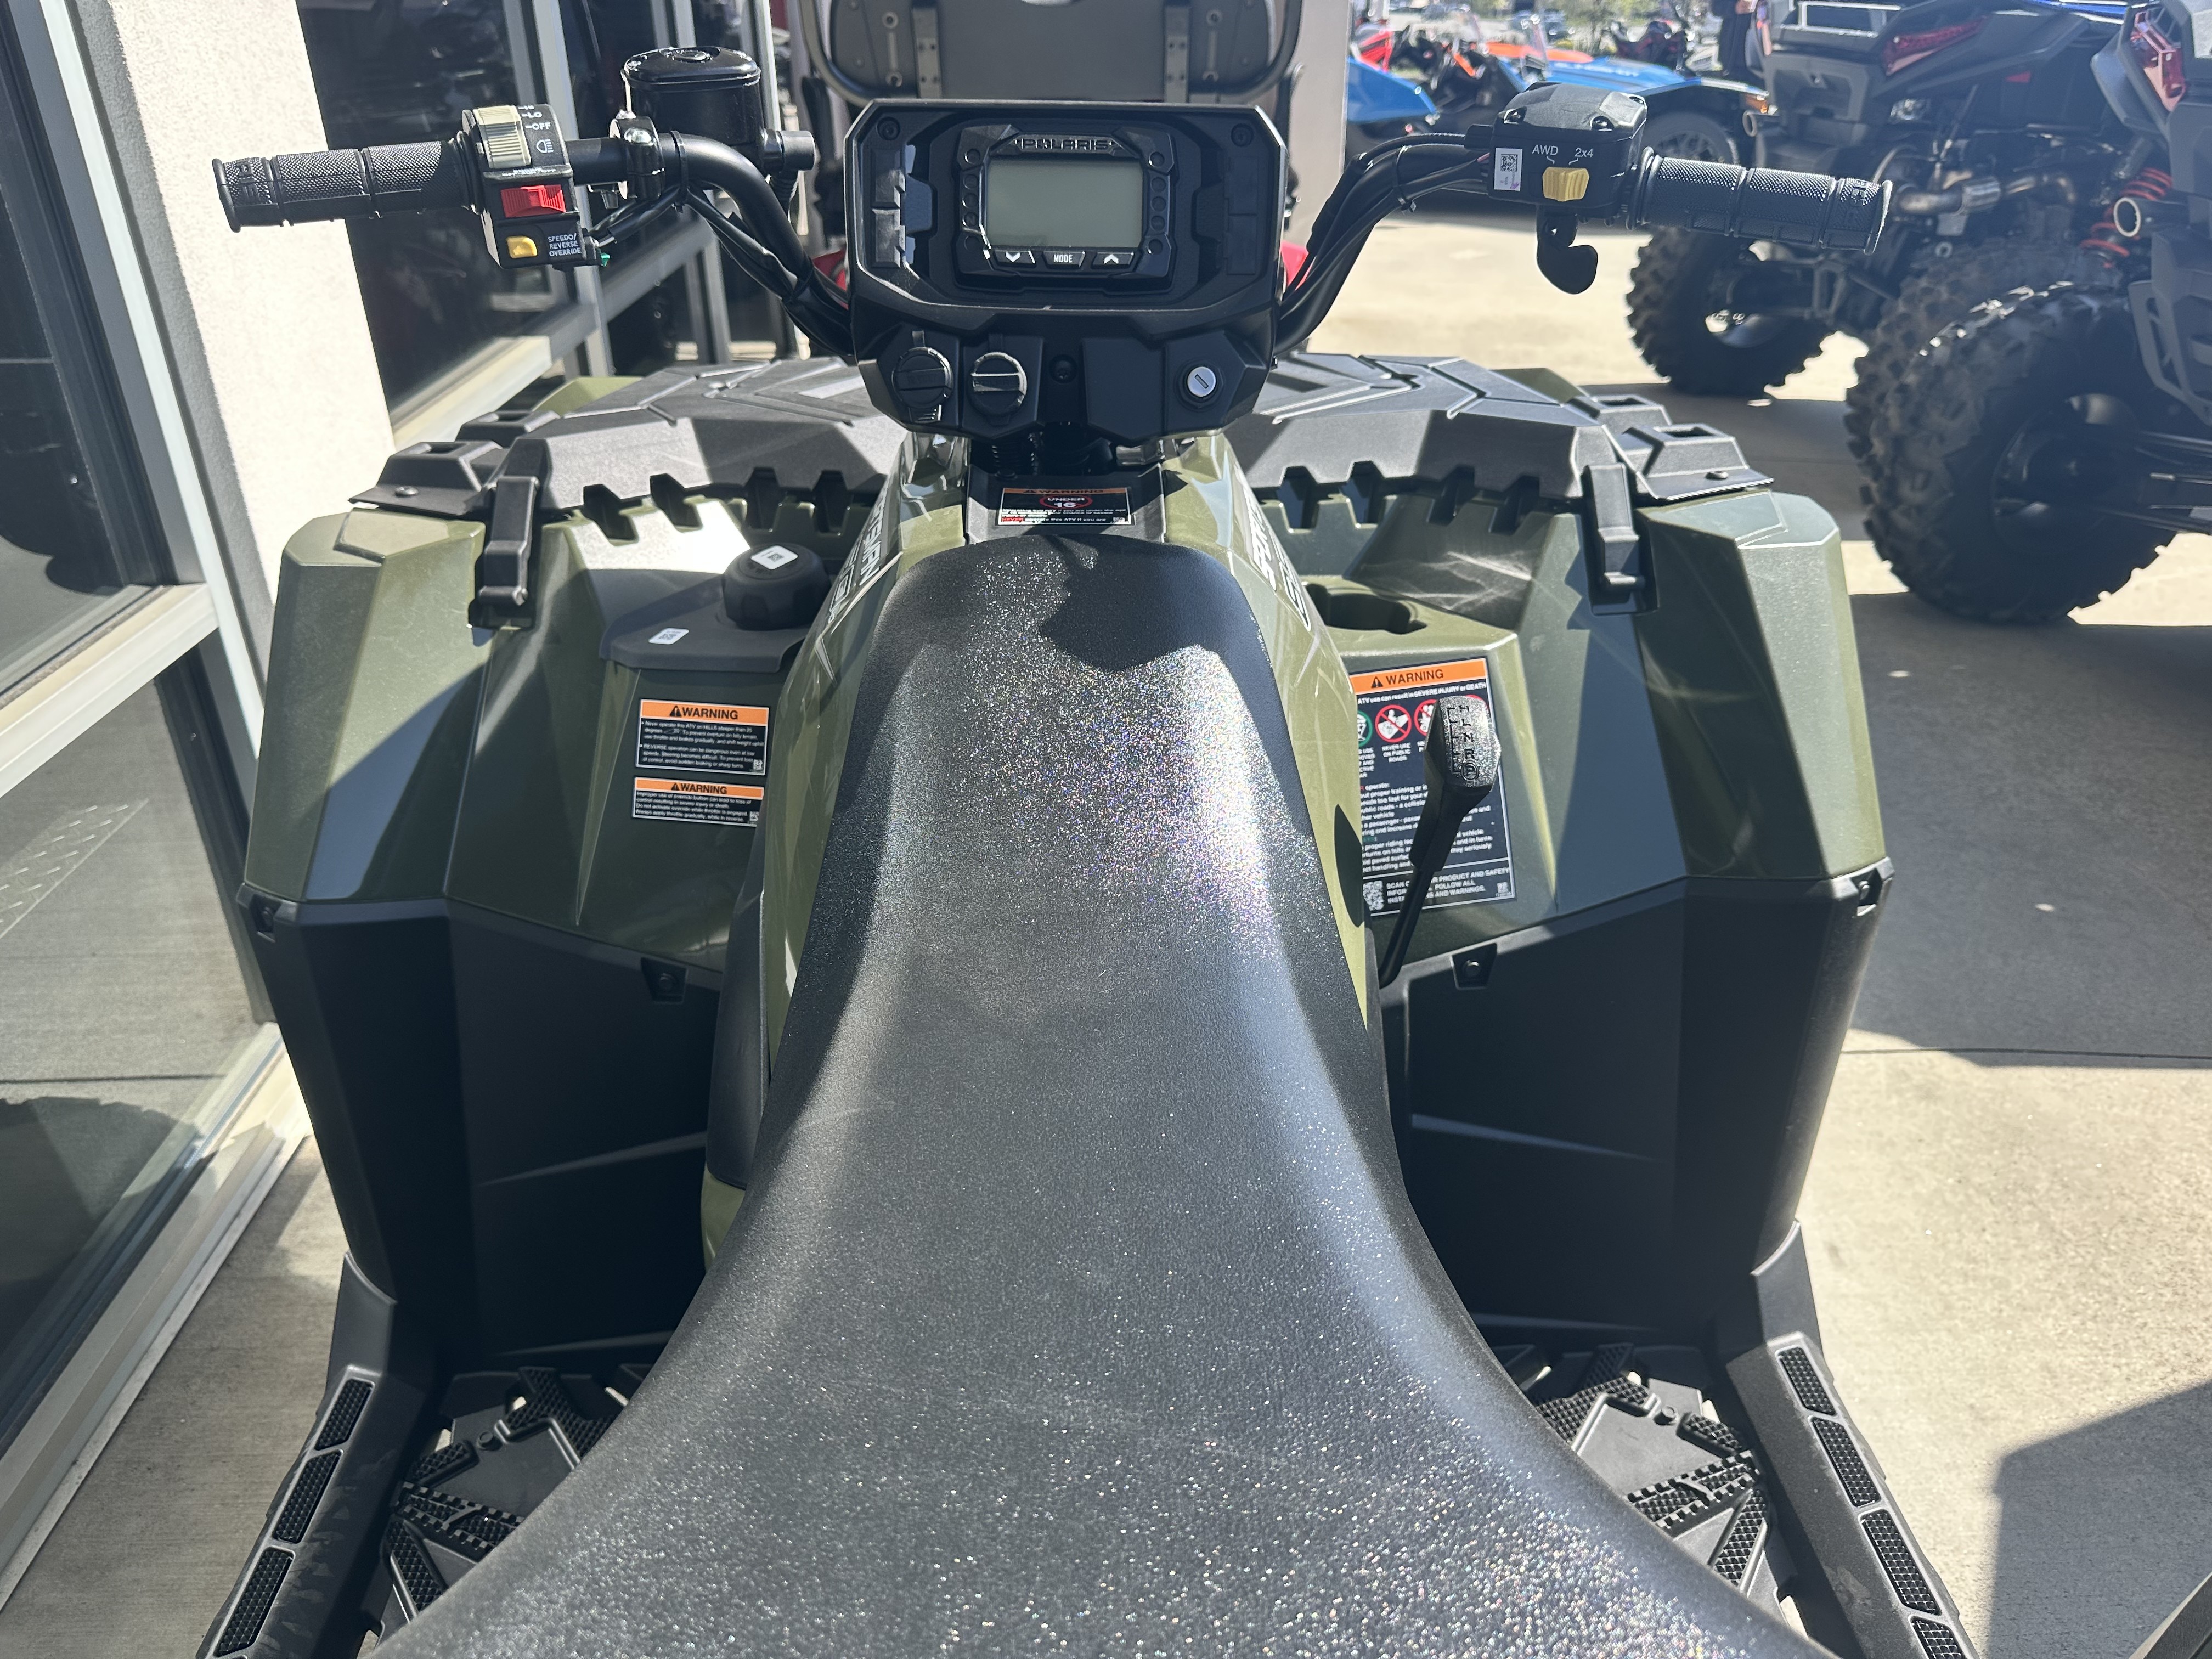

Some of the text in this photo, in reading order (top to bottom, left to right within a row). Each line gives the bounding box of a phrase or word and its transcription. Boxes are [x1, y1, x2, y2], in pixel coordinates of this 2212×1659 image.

[532, 122, 551, 131] OFF
[1020, 138, 1108, 150] POLARIS
[1532, 144, 1558, 156] AWD
[1575, 147, 1594, 158] 2x4
[548, 232, 577, 242] SPEEDO/
[549, 240, 579, 250] REVERSE
[549, 247, 582, 257] OVERRIDE
[1053, 254, 1073, 263] MODE
[1386, 669, 1444, 685] WARNING
[1414, 688, 1438, 697] SEVERE
[1438, 685, 1460, 694] INJURY
[1465, 682, 1486, 691] DEATH
[682, 707, 738, 720] WARNING
[1462, 718, 1471, 726] L
[1463, 732, 1474, 742] N
[1464, 748, 1477, 760] R
[681, 783, 727, 794] WARNING
[1370, 790, 1390, 798] proper
[1391, 787, 1414, 795] training
[1410, 793, 1423, 801] your
[1373, 811, 1395, 820] vehicle
[1369, 819, 1400, 828] passenger
[1387, 824, 1413, 832] increase
[1462, 828, 1484, 837] vehicle
[1464, 843, 1492, 851] seriously
[1372, 863, 1399, 871] handling
[1386, 881, 1406, 890] SCAN
[1438, 872, 1470, 883] PRODUCT
[1470, 870, 1485, 879] AND
[1485, 867, 1509, 877] SAFETY
[1434, 881, 1463, 890] FOLLOW
[1435, 889, 1449, 898] AND
[1449, 885, 1486, 896] WARNINGS.
